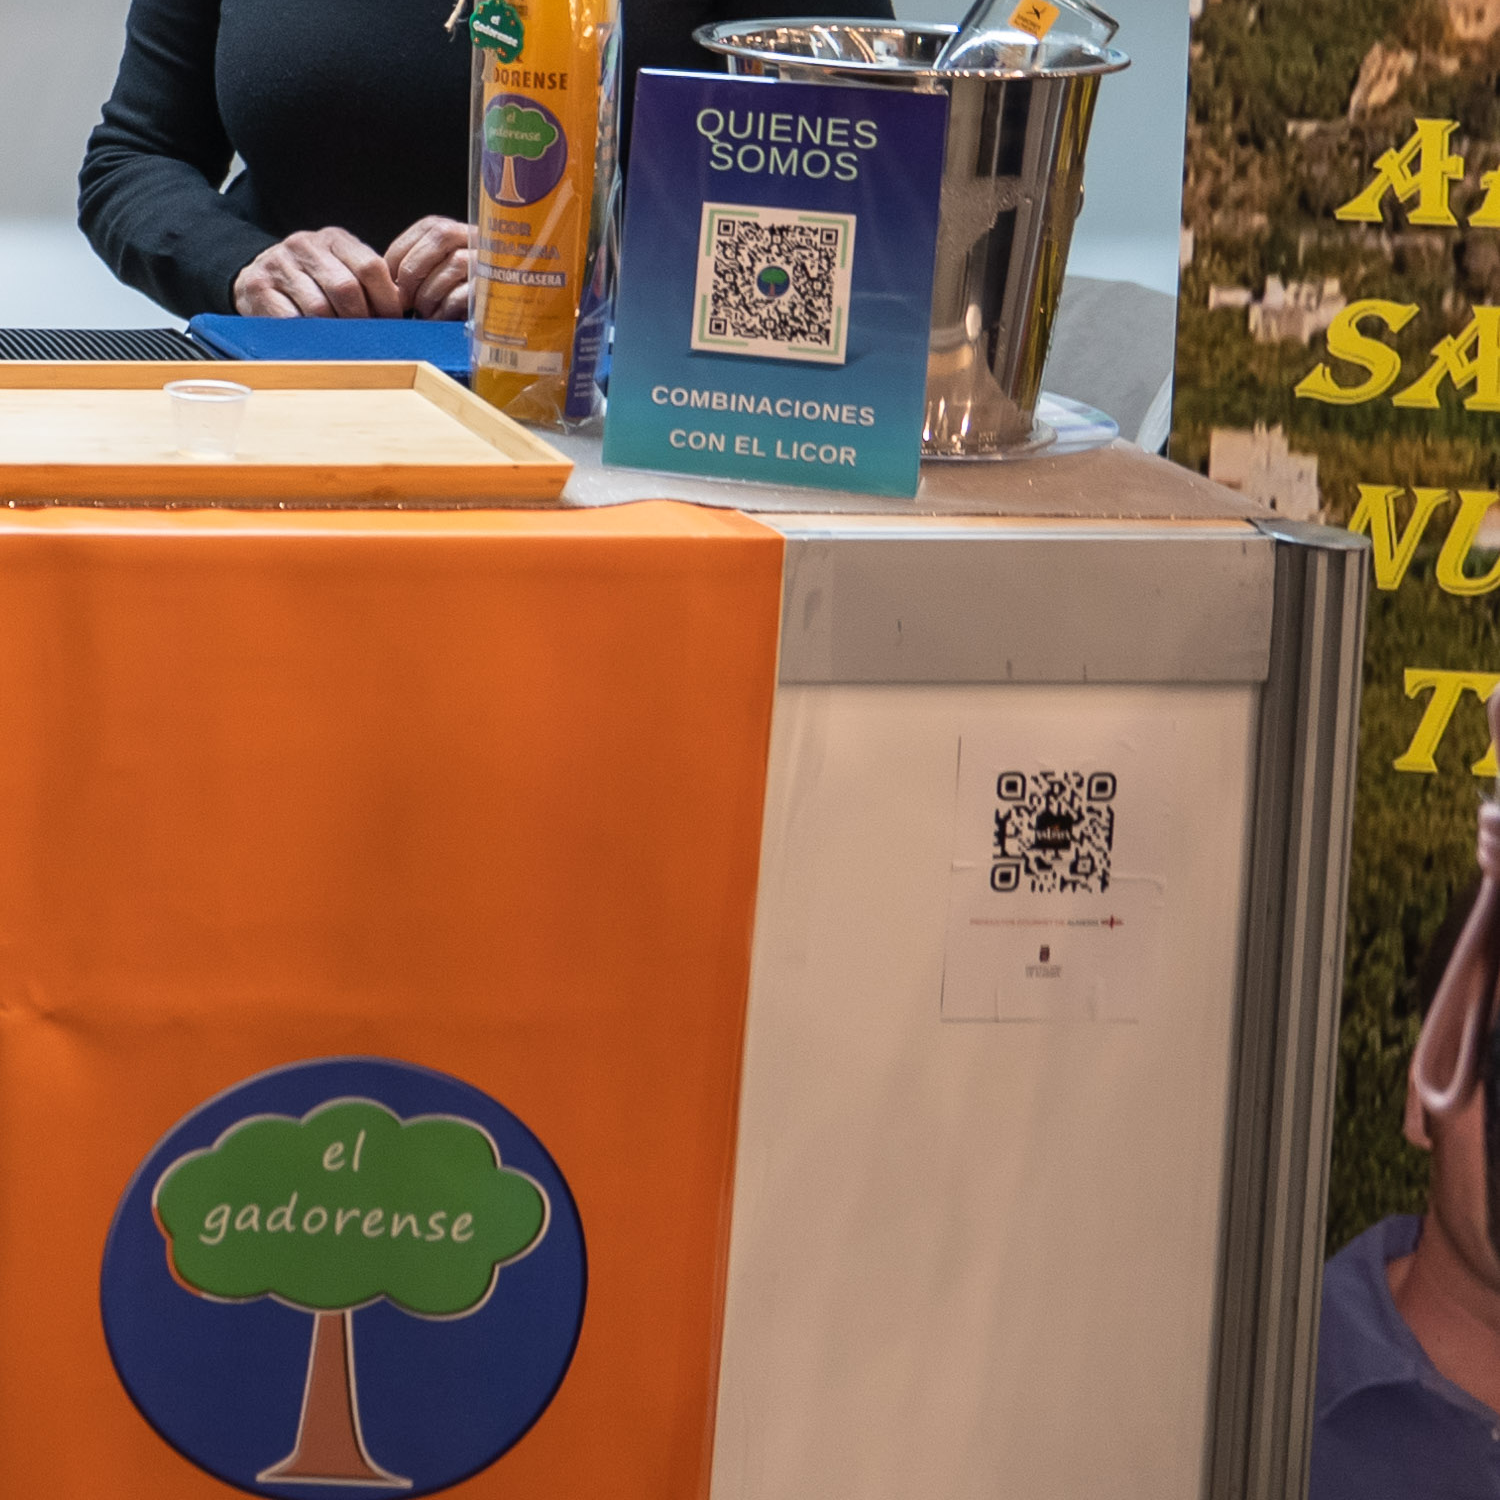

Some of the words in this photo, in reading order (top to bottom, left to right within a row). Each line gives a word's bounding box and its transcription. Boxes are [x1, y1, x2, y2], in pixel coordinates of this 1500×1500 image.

[493, 69, 569, 91] DORENSE
[696, 108, 879, 150] QUIENES
[709, 142, 859, 181] SOMOS
[521, 272, 563, 287] CASERA
[651, 385, 875, 427] COMBINACIONES
[669, 429, 726, 453] CON
[734, 435, 766, 457] EL
[775, 439, 857, 467] LICOR
[322, 1129, 366, 1173] el
[199, 1191, 474, 1245] gadorense
